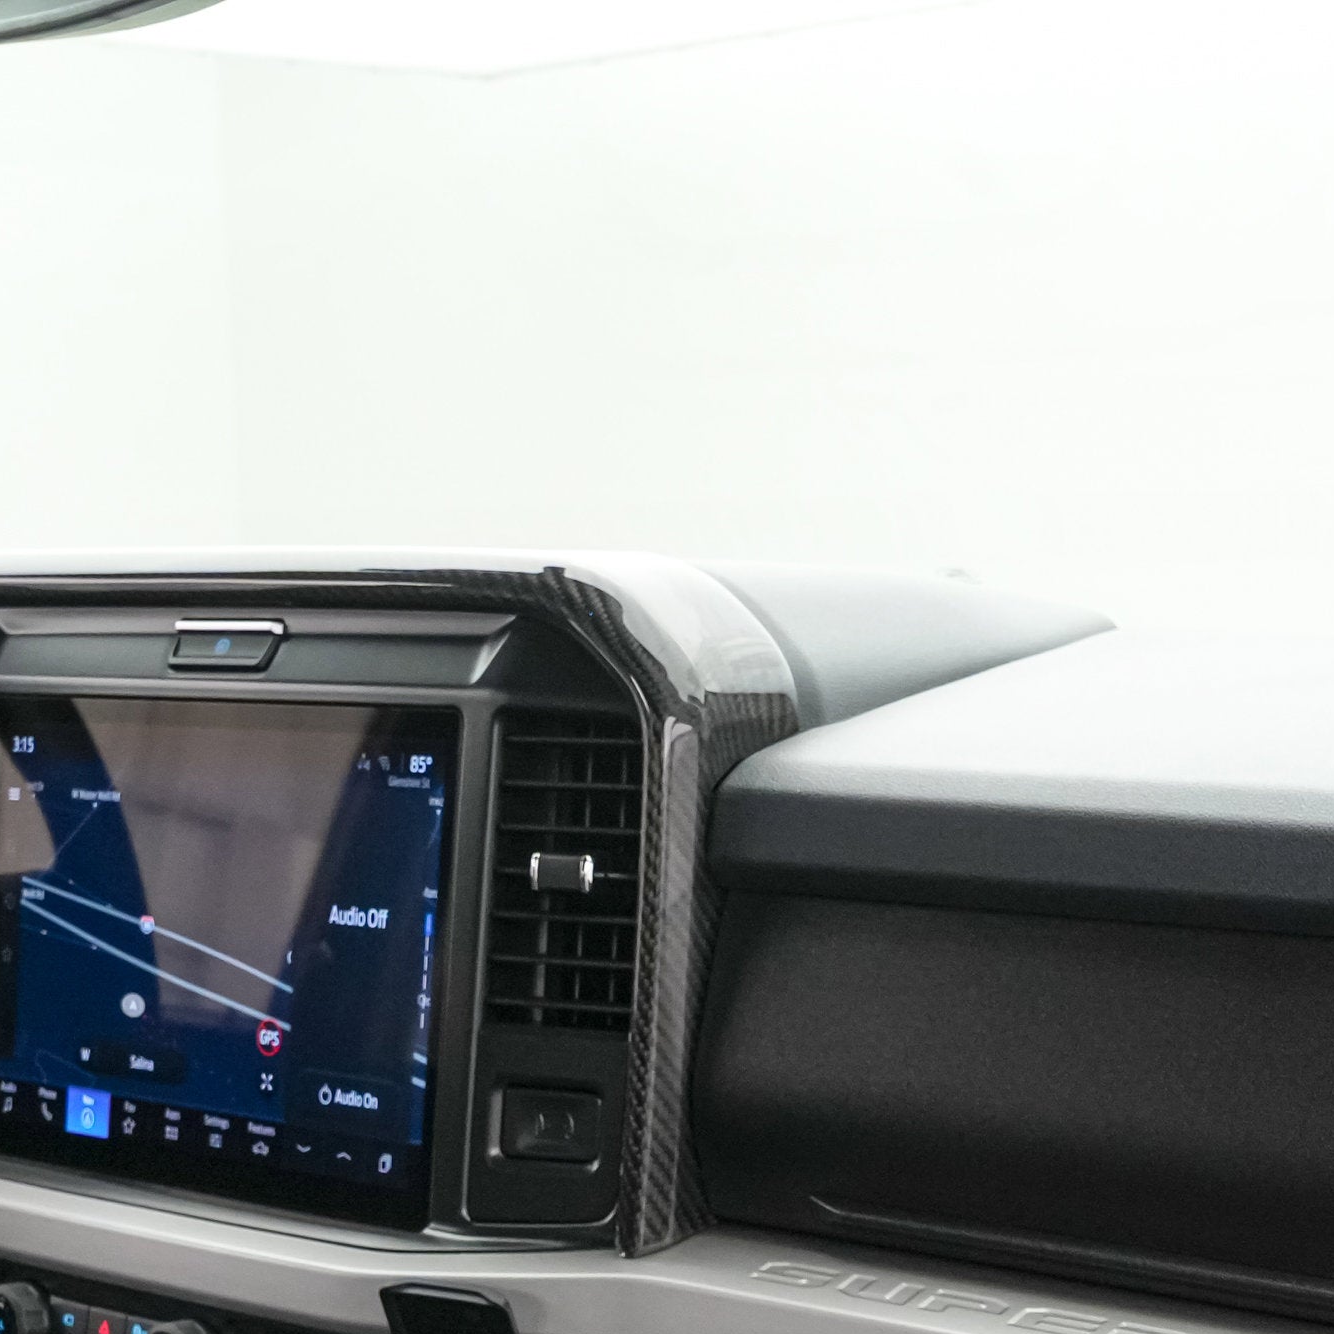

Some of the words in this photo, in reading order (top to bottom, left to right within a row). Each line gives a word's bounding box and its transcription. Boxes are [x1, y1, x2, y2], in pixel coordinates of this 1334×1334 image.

[12, 735, 35, 753] 3:15
[409, 754, 433, 773] 85°
[328, 904, 367, 927] Audio
[367, 908, 388, 929] Off
[258, 1029, 280, 1047] GPS
[334, 1088, 363, 1108] Audio
[362, 1092, 378, 1110] On
